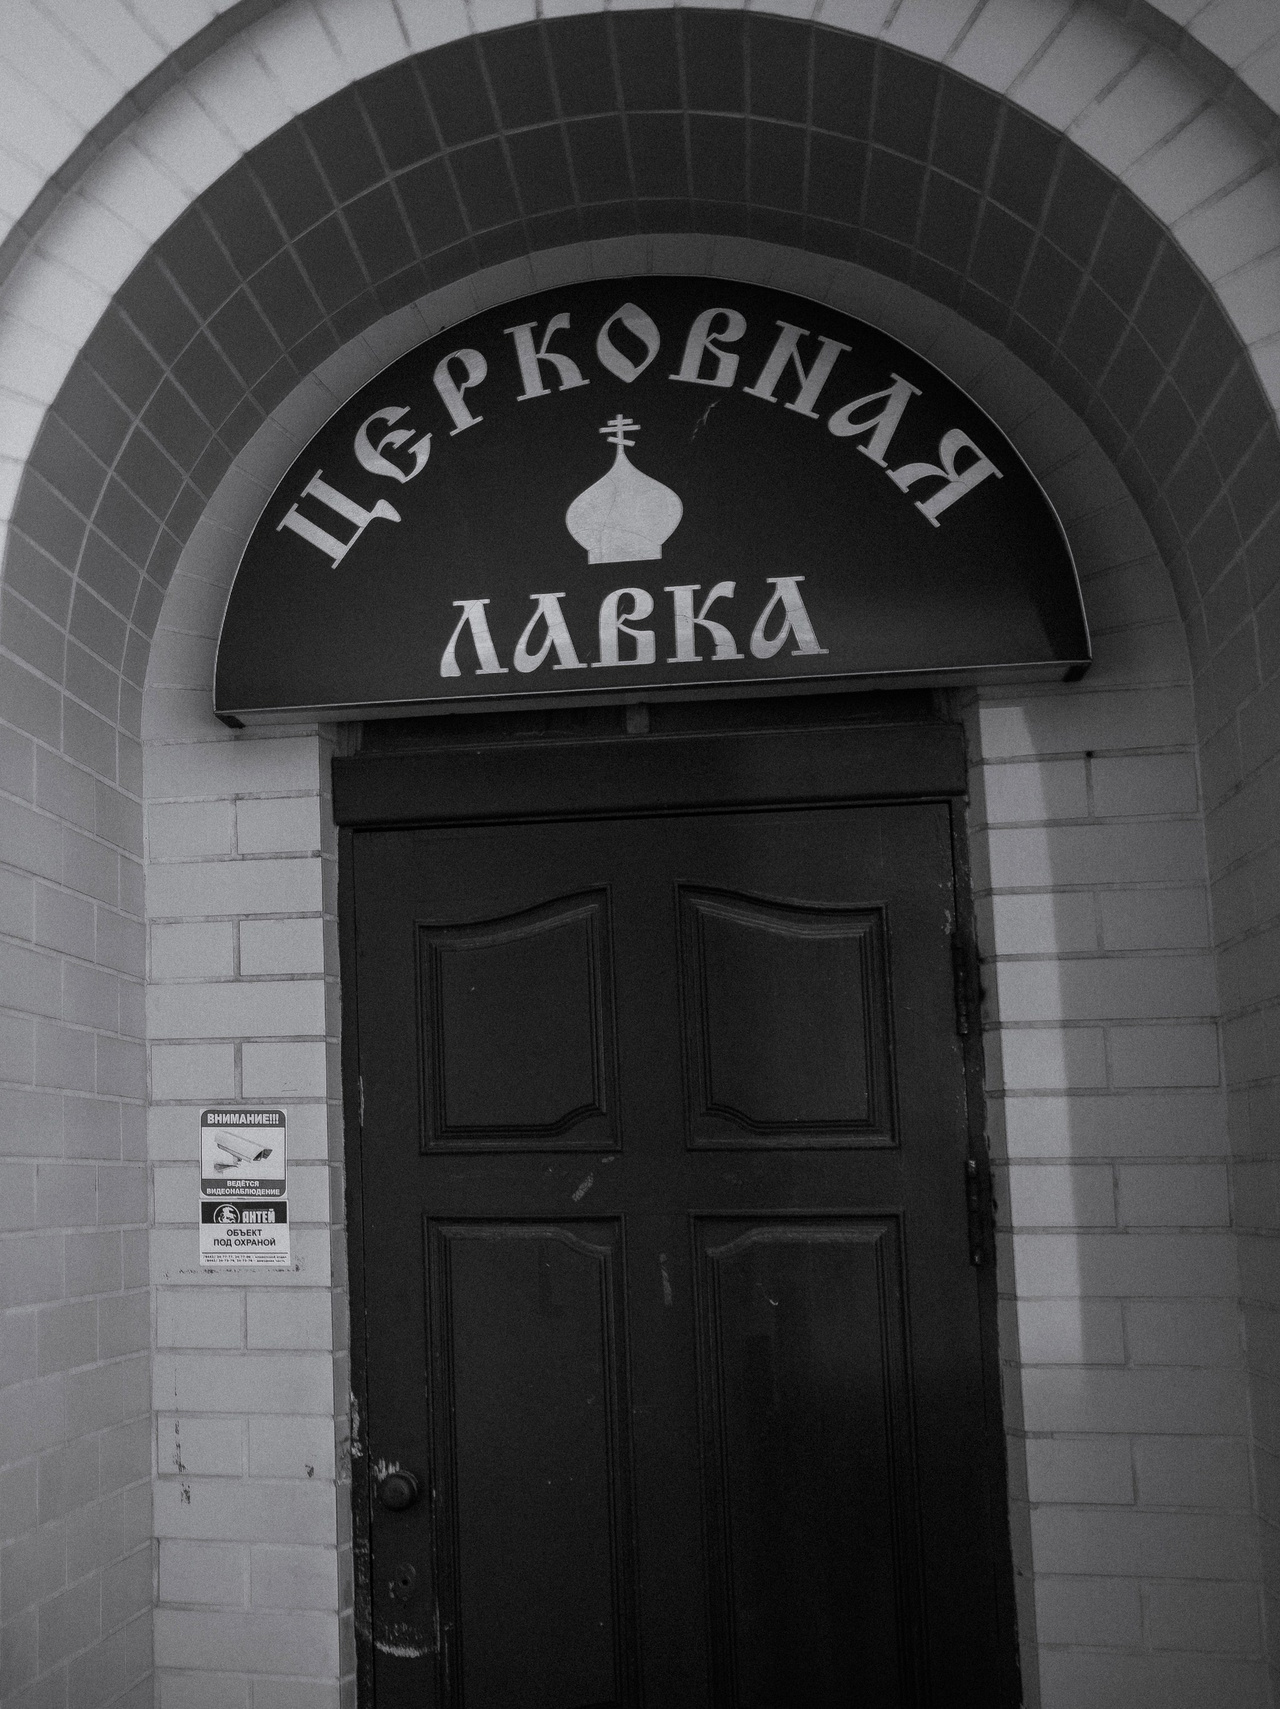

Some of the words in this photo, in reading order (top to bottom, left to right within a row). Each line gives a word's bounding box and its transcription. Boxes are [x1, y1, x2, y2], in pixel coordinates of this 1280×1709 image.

[276, 302, 1003, 568] ЦЕРКОВНАЯ
[440, 576, 829, 678] ЛАВКА
[207, 1113, 279, 1125] ВНИМАНИЕ!!!
[206, 1187, 280, 1196] ВИДЕОНАБЛЮДЕНИЕ
[242, 1208, 276, 1223] АНТЕЙ
[226, 1229, 263, 1237] ОБЪЕКТ
[213, 1238, 233, 1247] ПОД
[234, 1237, 276, 1247] ОХРАНОЙ
